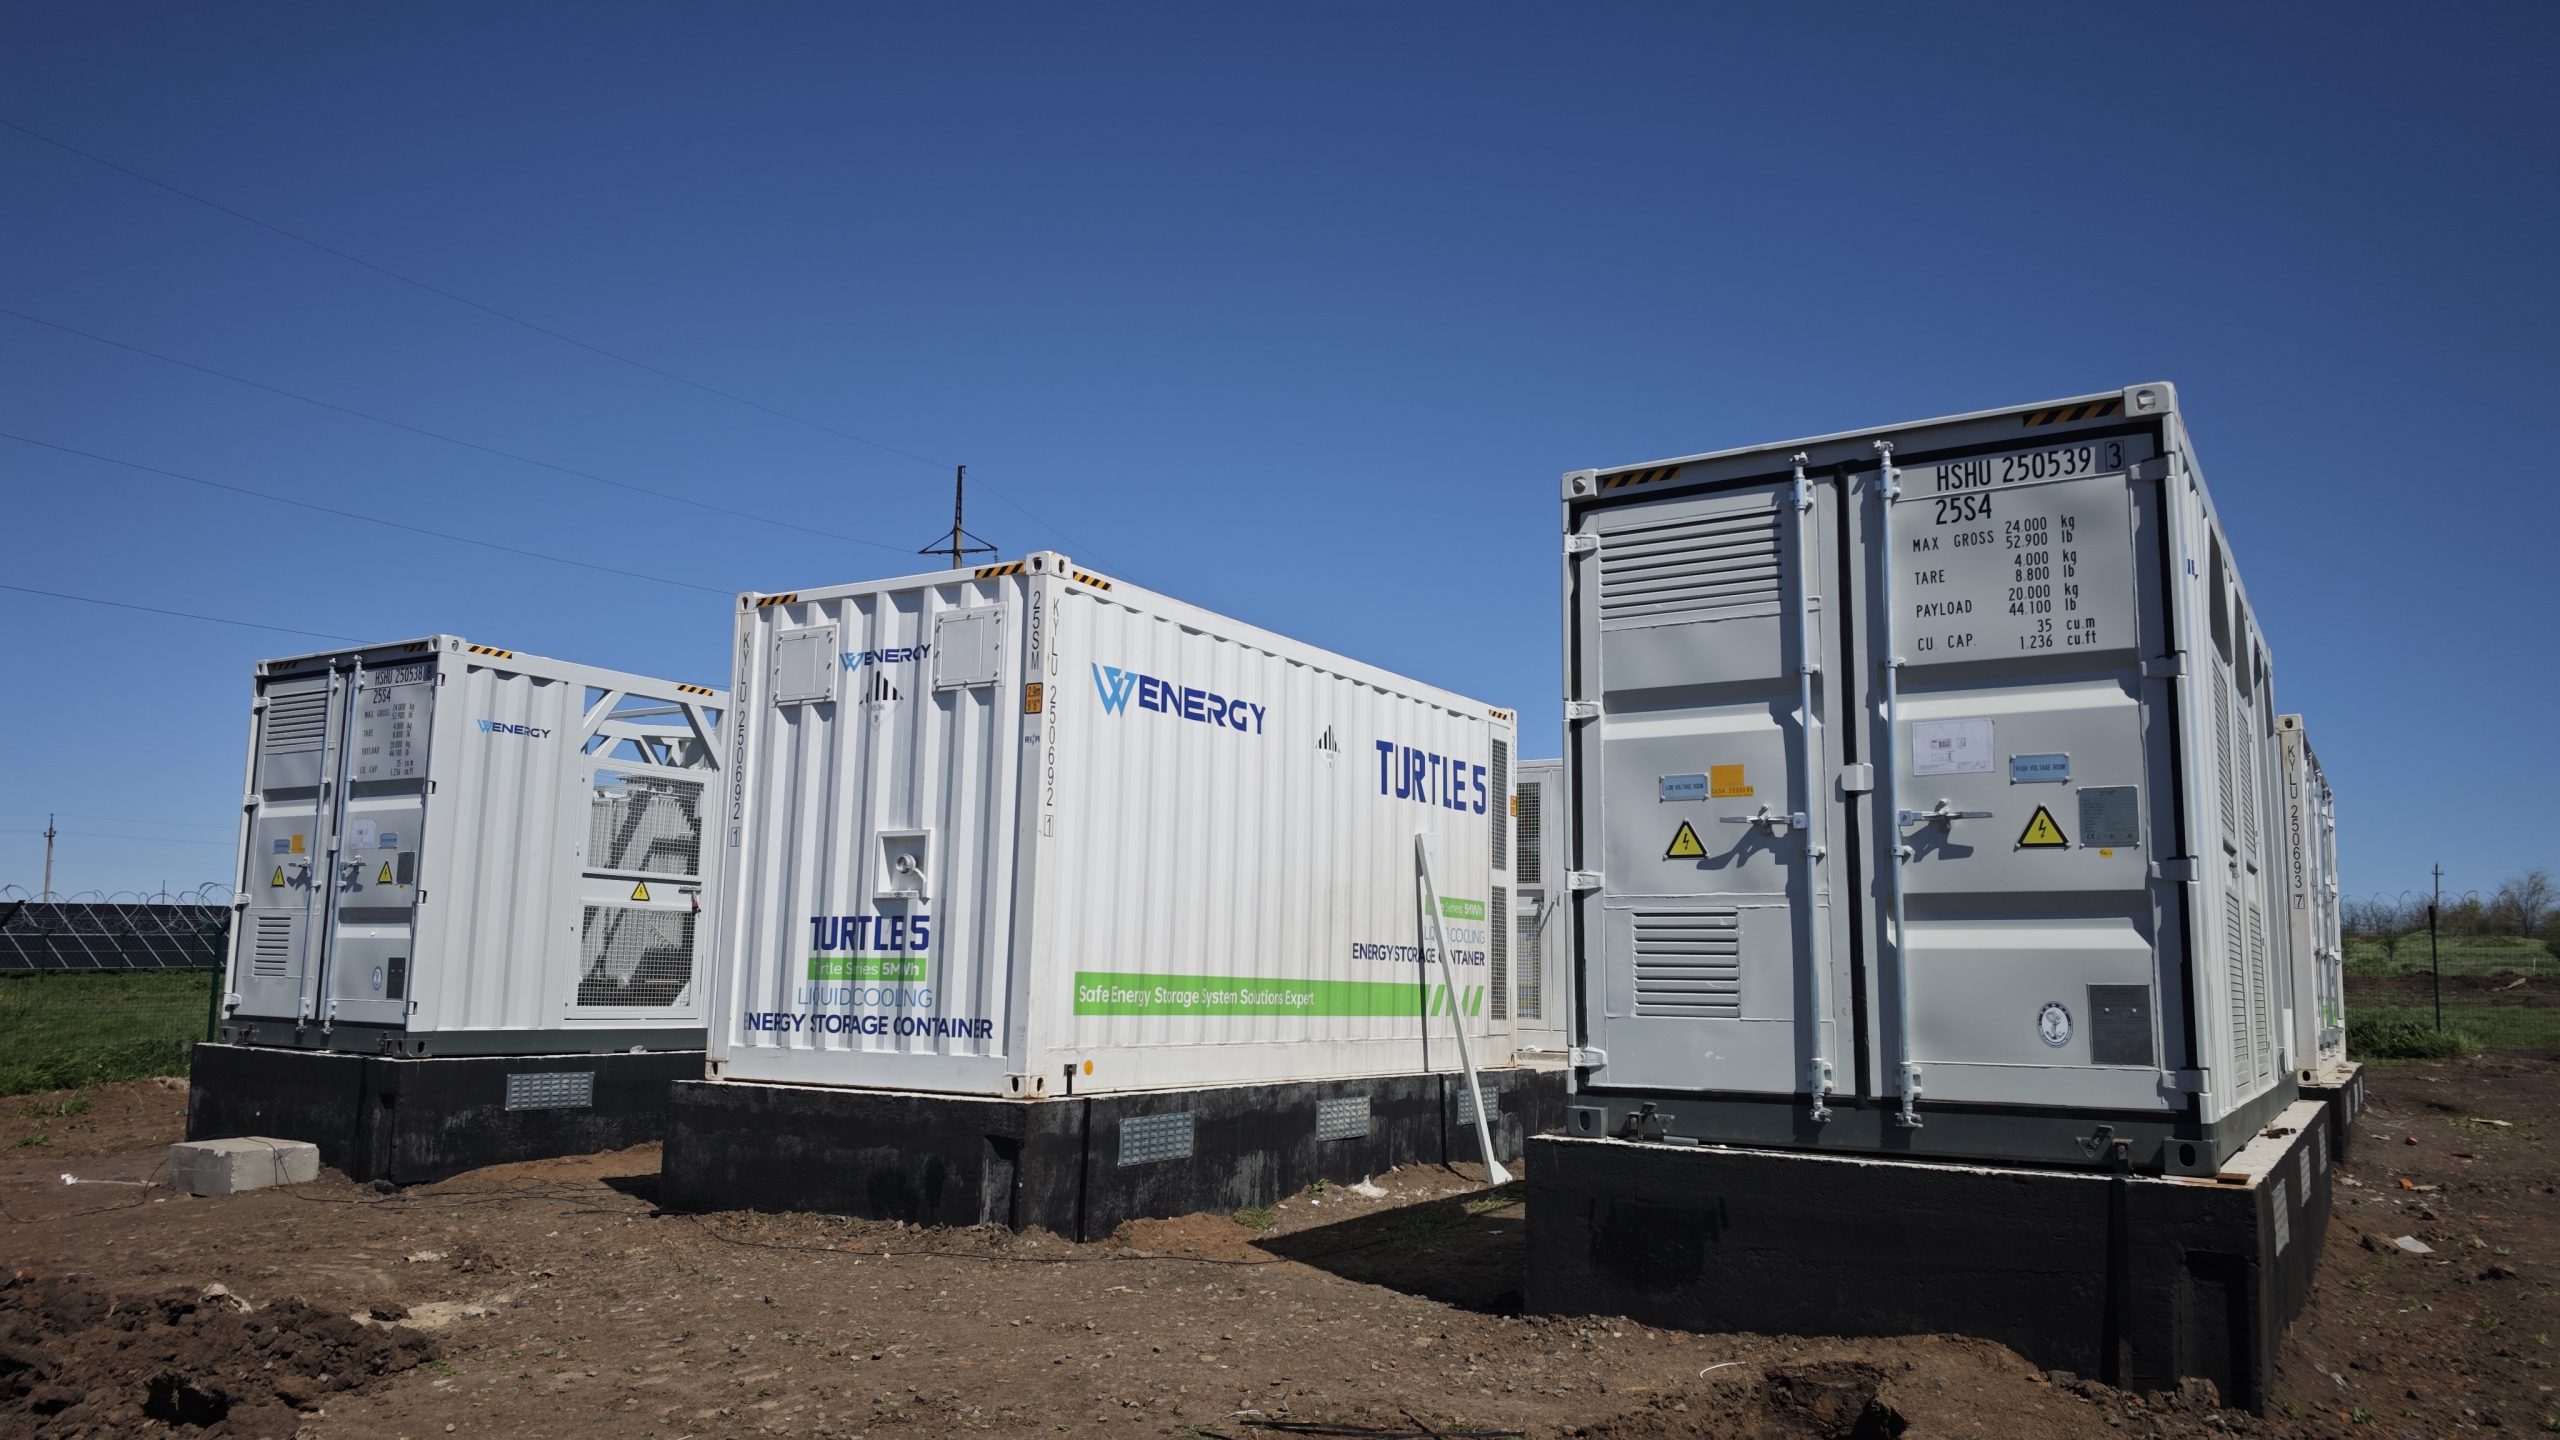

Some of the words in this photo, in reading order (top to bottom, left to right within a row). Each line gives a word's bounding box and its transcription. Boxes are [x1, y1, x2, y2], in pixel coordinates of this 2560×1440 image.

[1936, 459, 1991, 492] HSHU
[2002, 446, 2092, 483] 250539
[2108, 442, 2122, 469] 3
[1935, 493, 1992, 526] 25S4
[2005, 516, 2047, 534] 24.000
[2061, 514, 2075, 530] kg
[1912, 537, 1939, 552] MAX
[1954, 530, 1994, 548] GROSS
[2006, 532, 2048, 549] 52.900
[2062, 530, 2073, 544] lb
[2014, 551, 2049, 567] 4.000
[2063, 549, 2077, 565] kg
[1915, 569, 1946, 585] TARE
[2015, 566, 2050, 582] 8.800
[2063, 564, 2075, 578] lb
[2008, 584, 2051, 601] 20.000
[2064, 582, 2078, 598] kg
[1916, 599, 1972, 618] PAYLOAD
[2009, 599, 2051, 616] 44.100
[2065, 598, 2077, 611] lb
[1031, 590, 1041, 671] 25SM
[1050, 597, 1060, 676] KYLU
[2037, 618, 2052, 633] 35
[2066, 617, 2095, 630] cu.m
[2020, 634, 2053, 650] 1.236
[2067, 630, 2096, 646] cu.ft
[395, 666, 424, 684] 250538
[740, 632, 750, 703] KYLU
[373, 687, 391, 704] 25S4
[1091, 662, 1267, 735] WENERGY
[476, 719, 552, 739] WENERGY
[1046, 685, 1057, 807] 250692
[733, 710, 745, 820] 250692
[1376, 739, 1467, 812] TURTLE
[1472, 764, 1487, 815] 5
[2287, 744, 2298, 800] KYLU
[2290, 804, 2303, 889] 250693
[2294, 895, 2304, 909] 7
[811, 915, 904, 951] TURTLE
[909, 915, 930, 951] 5
[1352, 942, 1394, 961] ENERGY
[1438, 949, 1485, 966] NTANER
[813, 962, 842, 975] Trtle
[845, 962, 879, 975] Sries
[1079, 984, 1109, 1003] Safe
[1111, 985, 1151, 1007] Energy
[1154, 986, 1199, 1008] Storage
[1201, 986, 1237, 1008] System
[1240, 988, 1283, 1005] Solutions
[1285, 990, 1314, 1009] Expert
[810, 1014, 889, 1036] STORAGE
[893, 1016, 993, 1040] CONTAINER
